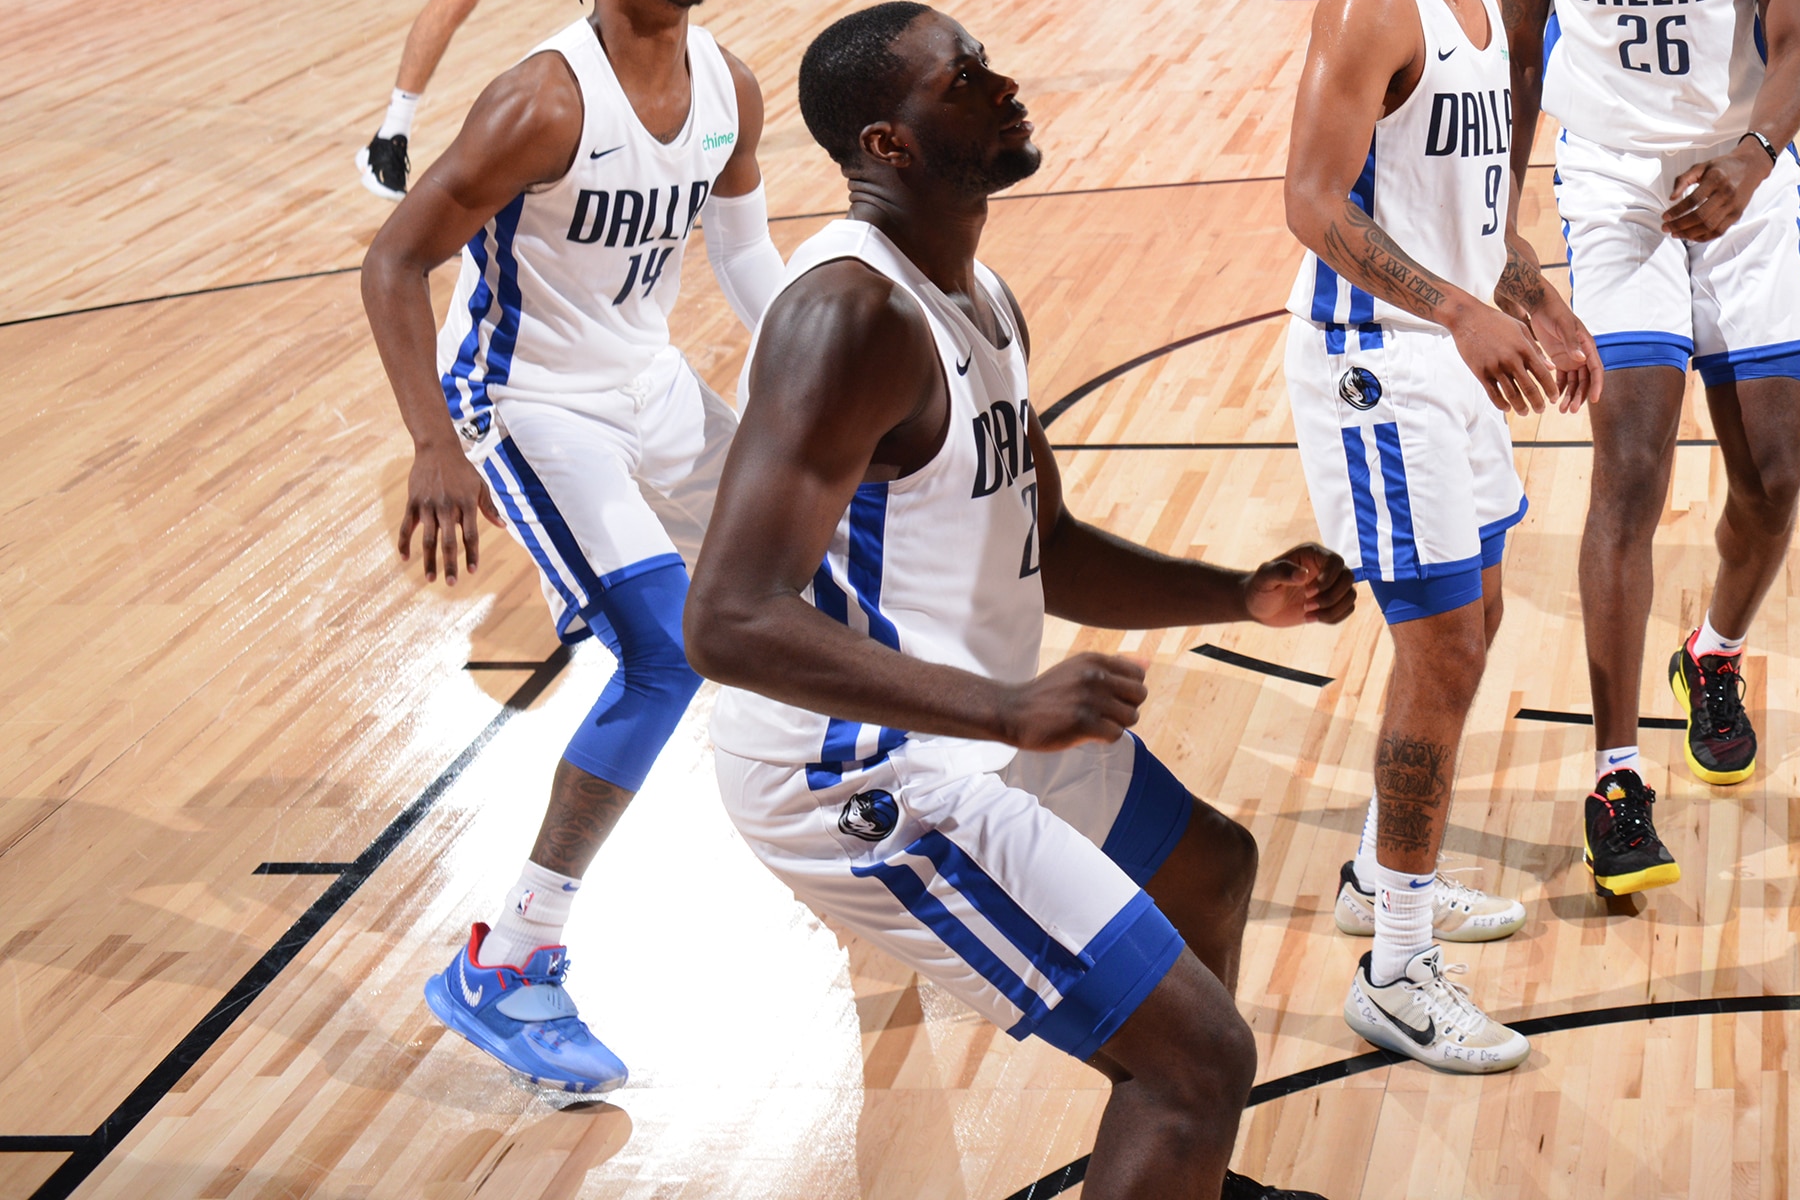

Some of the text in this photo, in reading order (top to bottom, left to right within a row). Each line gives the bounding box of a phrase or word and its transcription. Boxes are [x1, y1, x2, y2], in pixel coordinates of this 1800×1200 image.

[1617, 14, 1691, 76] 26
[703, 130, 735, 151] chime
[1424, 89, 1512, 157] DALLA
[566, 180, 710, 248] DALLA
[1481, 164, 1502, 237] 9
[611, 246, 675, 307] 14
[971, 399, 1036, 499] DAL
